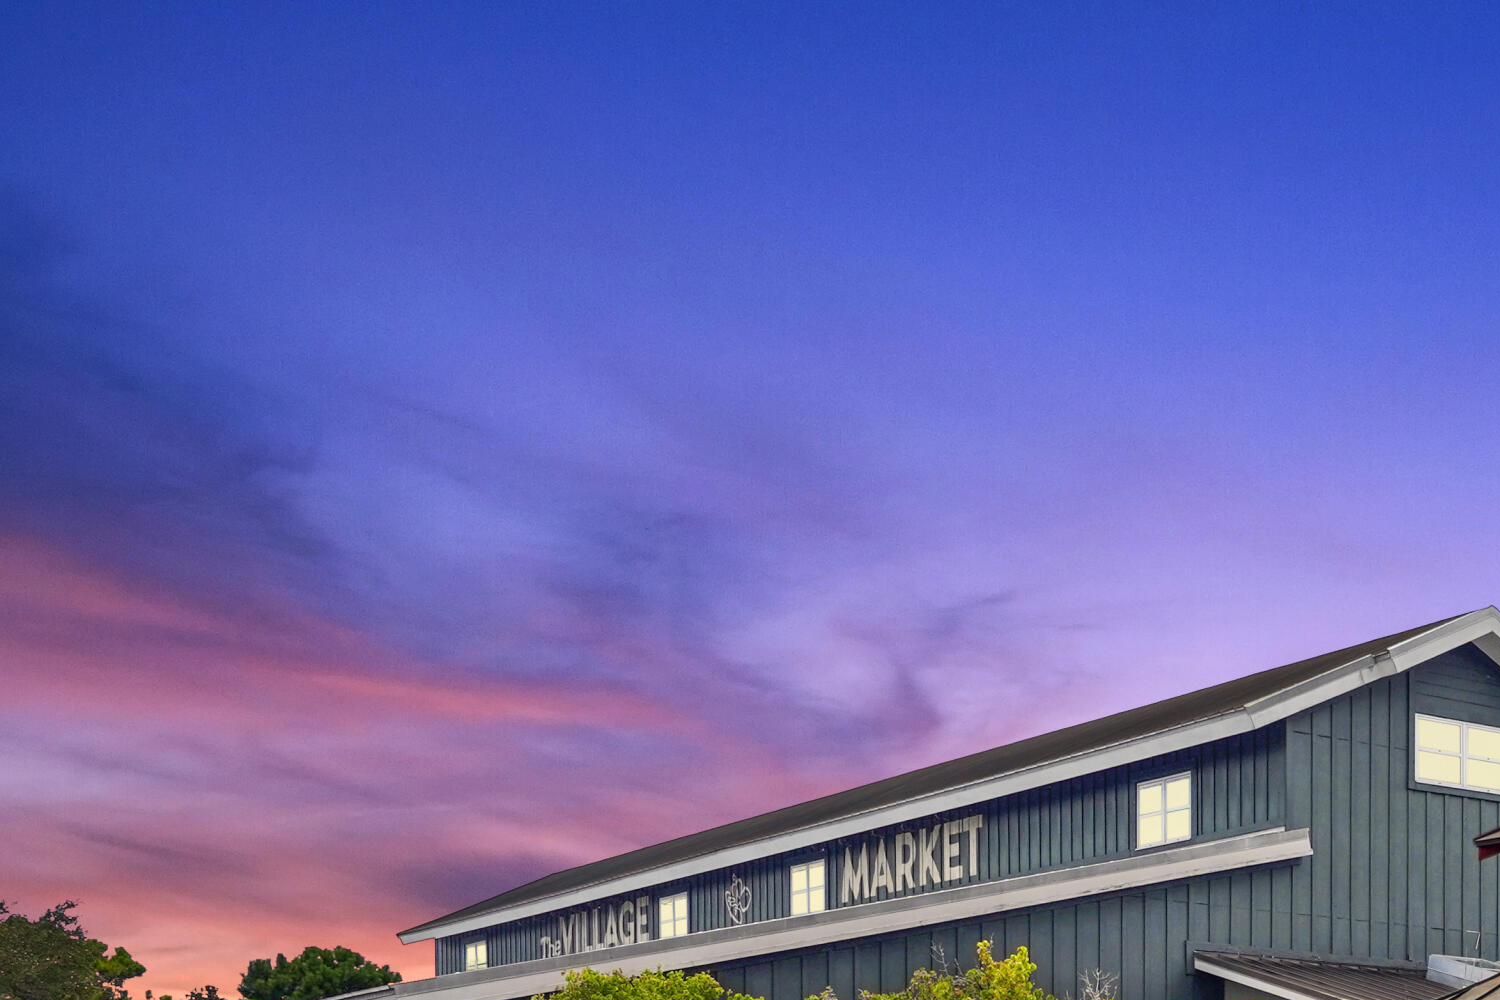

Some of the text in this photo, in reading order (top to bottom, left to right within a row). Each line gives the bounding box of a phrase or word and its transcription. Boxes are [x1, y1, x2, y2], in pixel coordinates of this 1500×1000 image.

[540, 814, 983, 959] The VILLAGE MARKET
